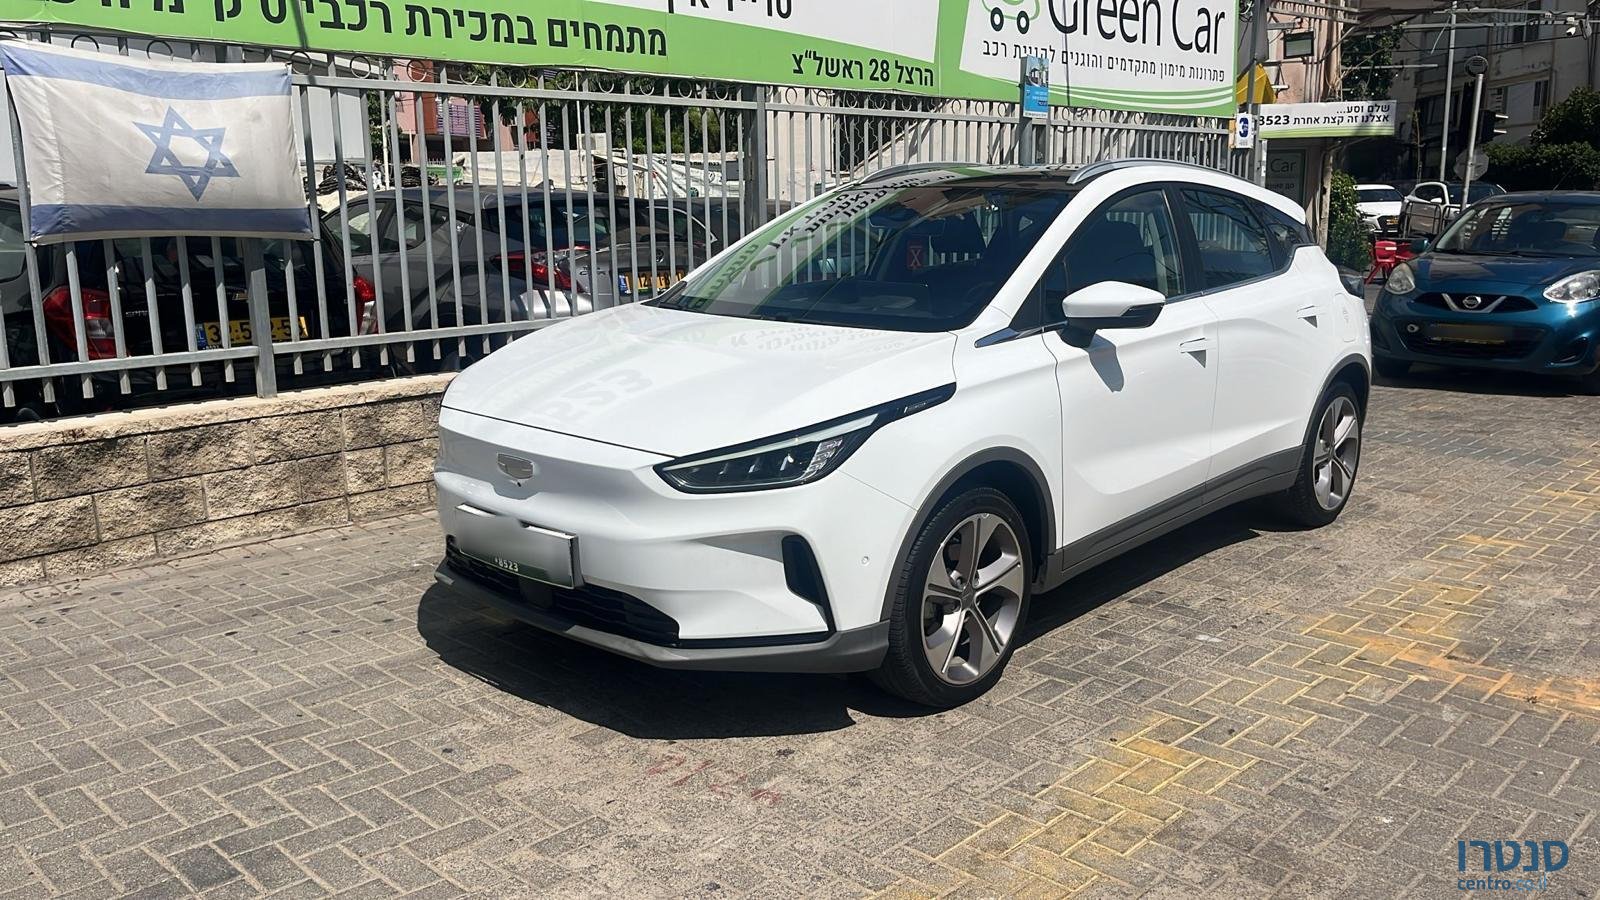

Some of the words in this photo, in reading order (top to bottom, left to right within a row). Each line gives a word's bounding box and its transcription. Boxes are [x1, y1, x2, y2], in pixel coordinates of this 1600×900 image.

[305, 0, 392, 33] רכבי
[404, 4, 537, 45] במכירת
[1048, 0, 1161, 46] Green
[1172, 0, 1226, 54] Car
[547, 18, 667, 56] מתמחים
[982, 40, 1007, 58] רכב
[1061, 50, 1102, 68] והוגנים
[1108, 56, 1156, 76] מתקדמים
[868, 58, 890, 82] 28
[895, 60, 934, 87] הרצל
[1160, 62, 1186, 80] מימון
[1189, 66, 1225, 82] פתרונות
[1367, 103, 1390, 113] שלם
[1293, 116, 1320, 125] אחרת
[1323, 115, 1344, 126] קצת
[1347, 115, 1359, 124] זה
[1361, 113, 1389, 123] אצלנו
[1270, 158, 1297, 173] Car
